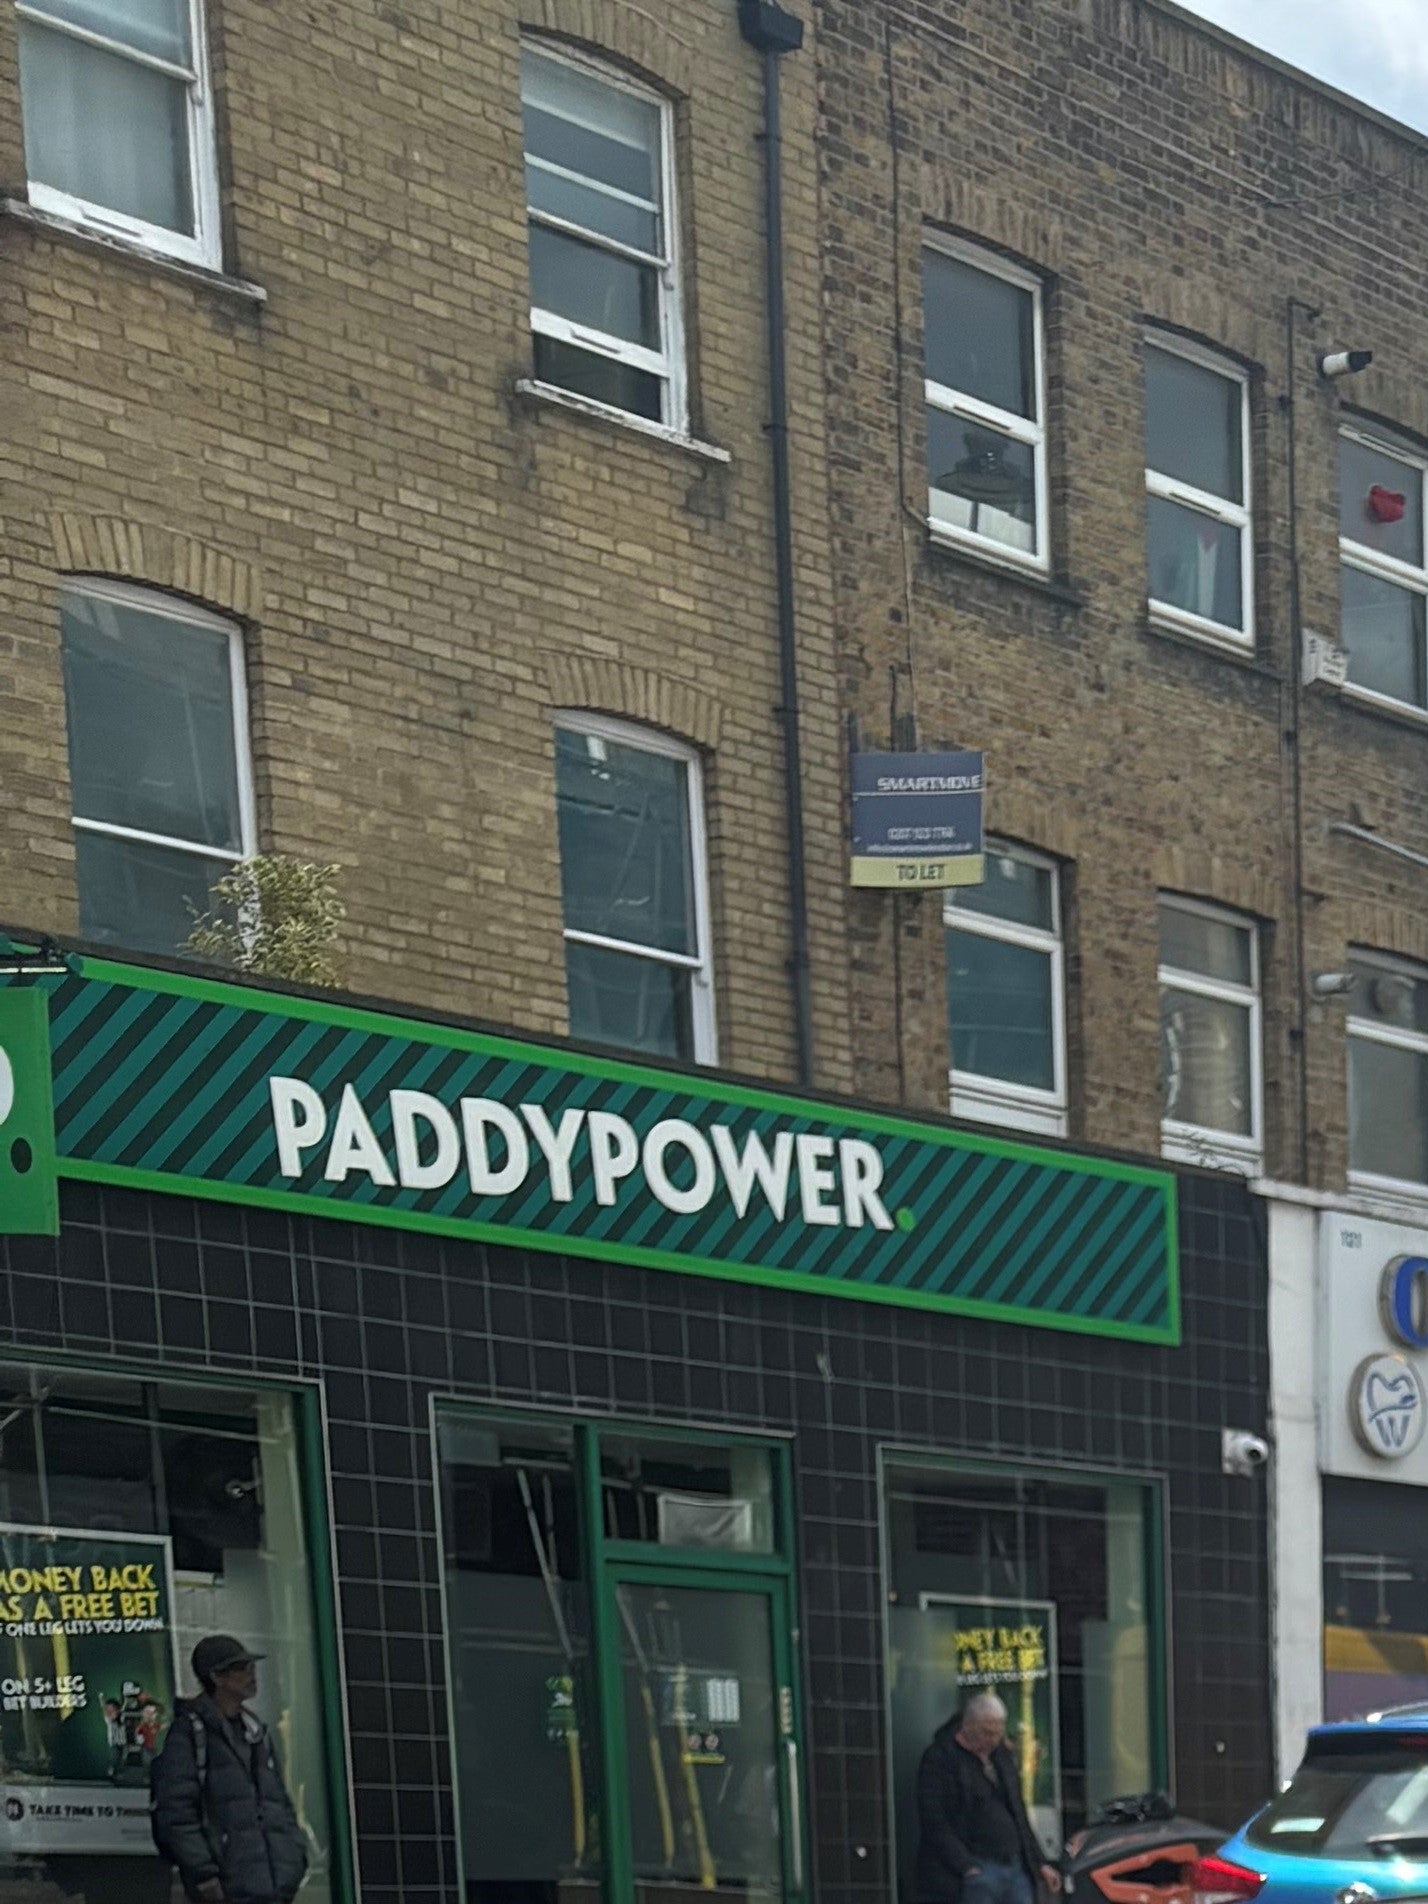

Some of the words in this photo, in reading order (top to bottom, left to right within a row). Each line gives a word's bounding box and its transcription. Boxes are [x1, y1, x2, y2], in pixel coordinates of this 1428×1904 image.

[896, 864, 916, 881] TO
[919, 864, 945, 881] LET
[91, 1564, 155, 1592] BACK
[34, 1597, 52, 1621] A
[59, 1592, 115, 1619] FREE
[120, 1590, 160, 1618] BET
[1, 1679, 29, 1695] ON
[56, 1675, 85, 1694] LEG
